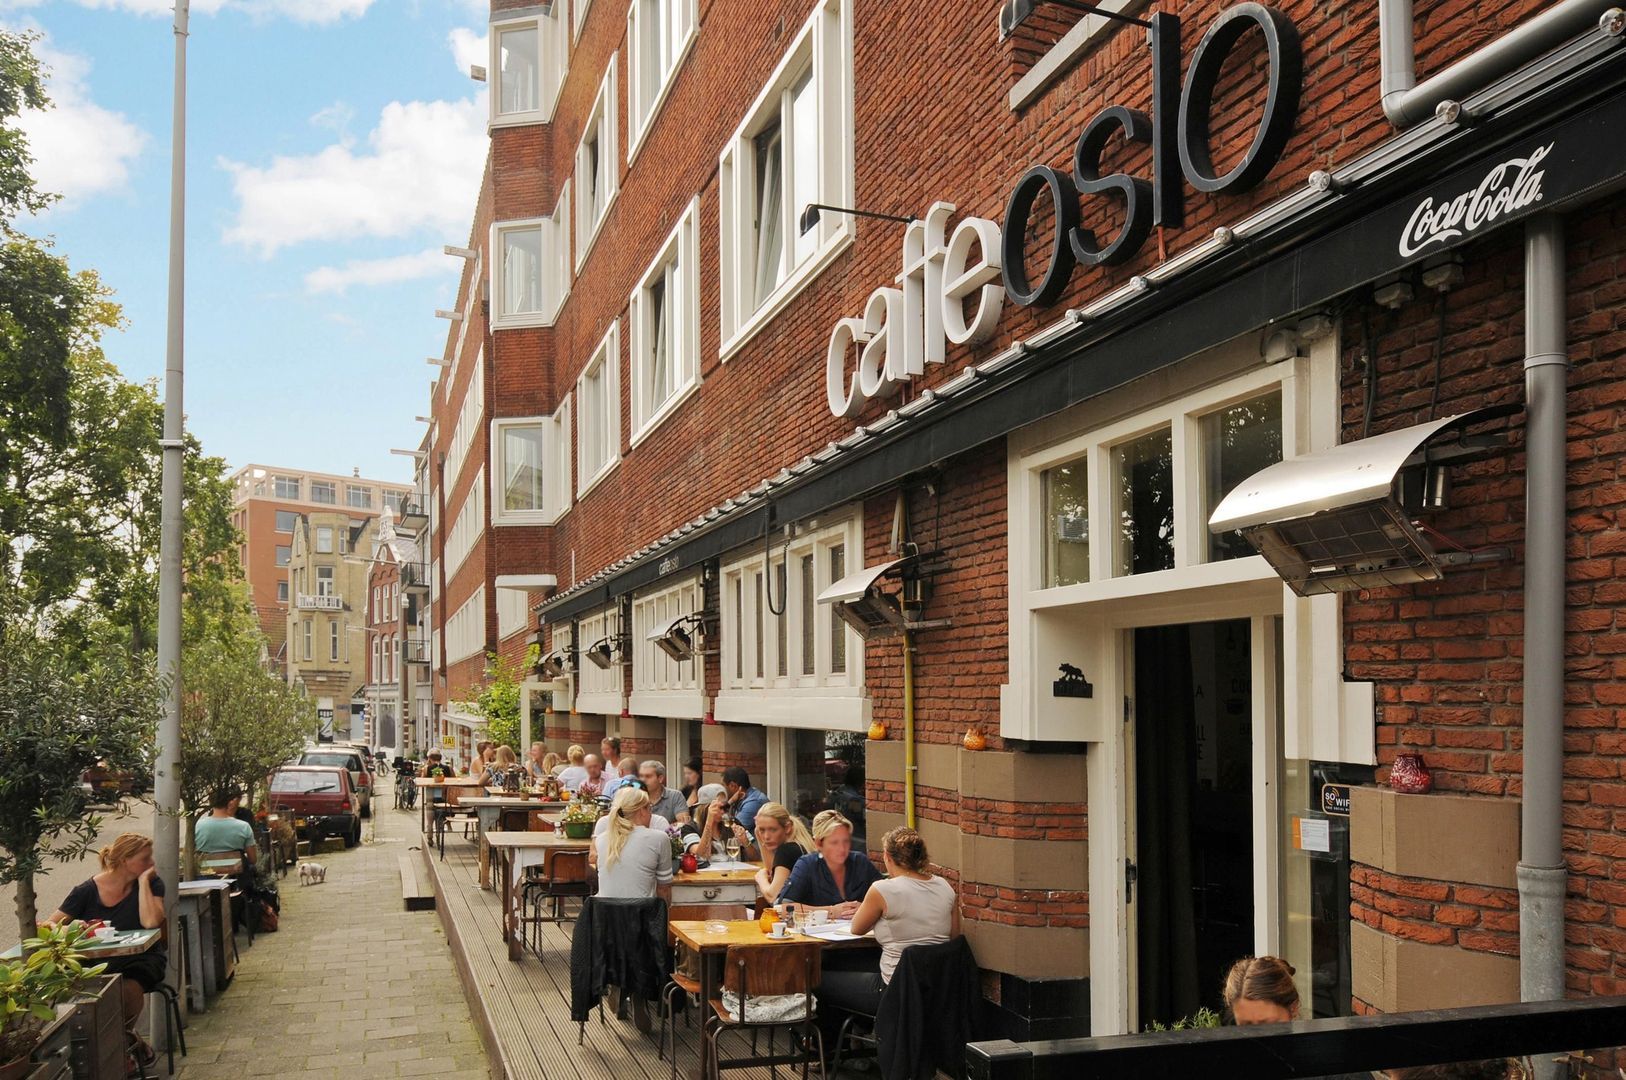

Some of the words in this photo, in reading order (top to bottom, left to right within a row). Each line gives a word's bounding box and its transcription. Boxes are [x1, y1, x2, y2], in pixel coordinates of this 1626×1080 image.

[1001, 1, 1303, 307] oslo
[1398, 141, 1555, 258] Coca-Cola
[1324, 792, 1336, 801] SO
